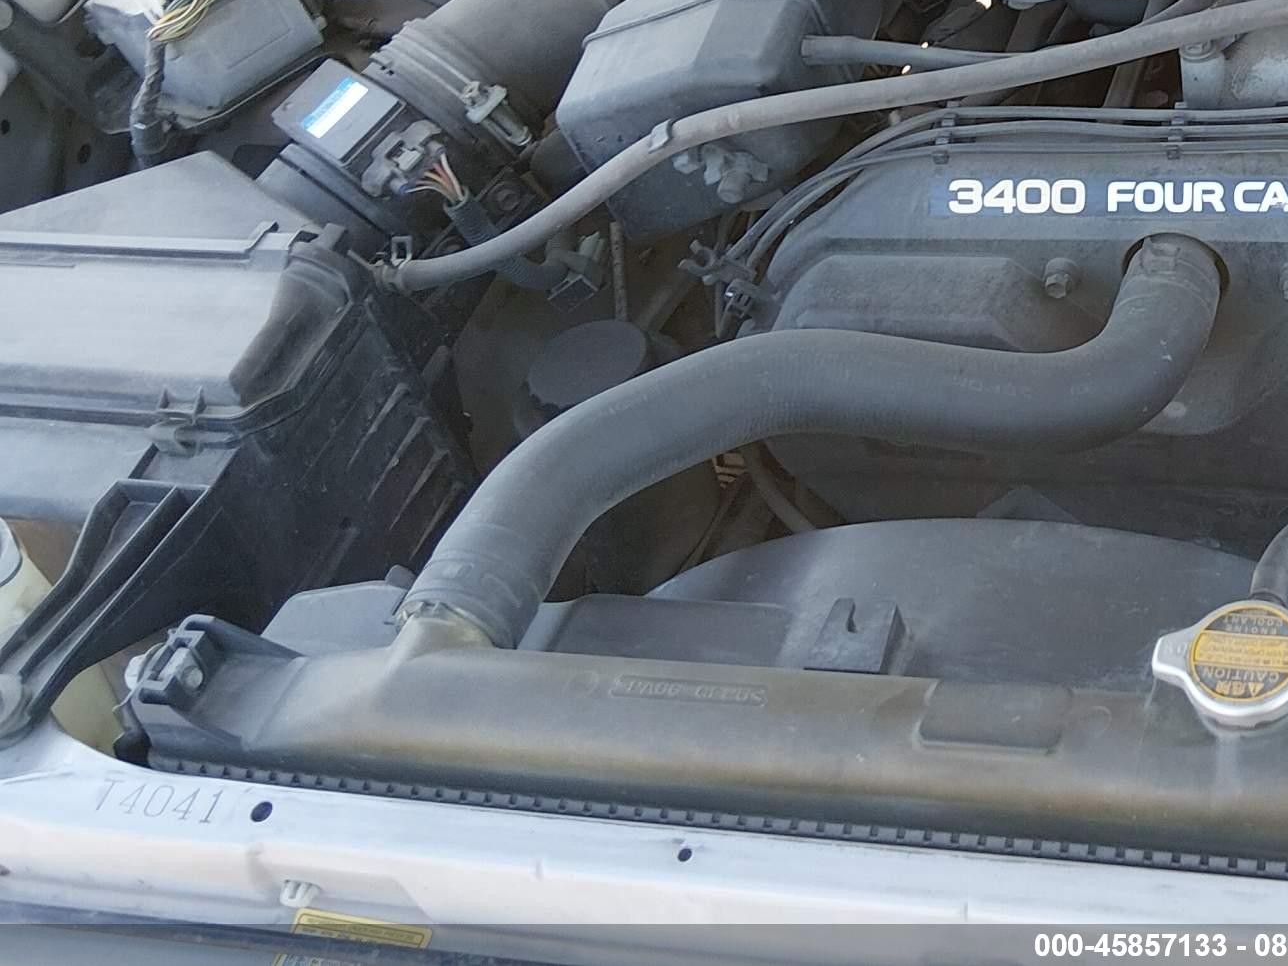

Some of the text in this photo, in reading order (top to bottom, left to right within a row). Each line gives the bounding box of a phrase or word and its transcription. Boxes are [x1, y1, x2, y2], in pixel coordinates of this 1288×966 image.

[948, 179, 1086, 214] 3400
[1107, 181, 1225, 212] FOUR
[1223, 614, 1284, 627] COOLANT
[1225, 625, 1278, 635] ENGINE
[1202, 667, 1280, 683] CAUTION
[96, 778, 224, 823] T4041
